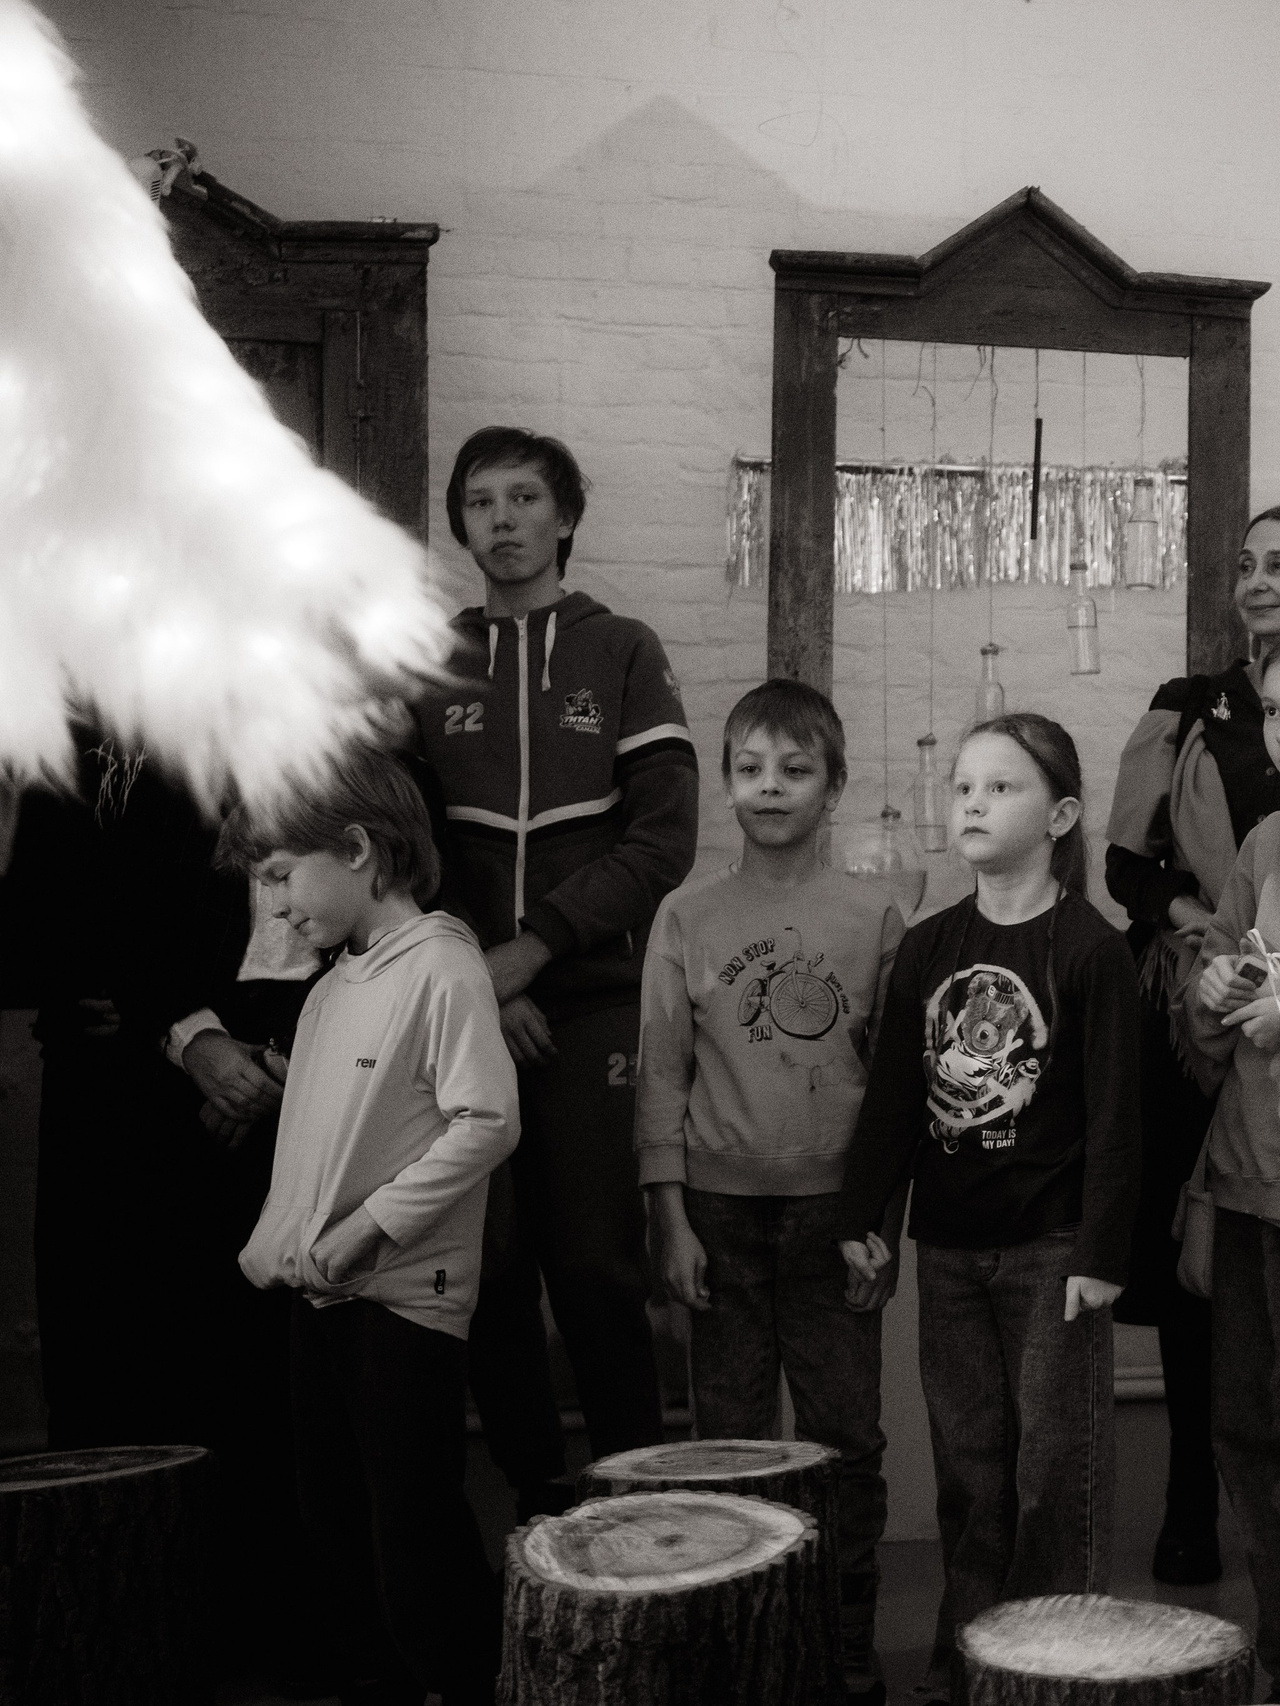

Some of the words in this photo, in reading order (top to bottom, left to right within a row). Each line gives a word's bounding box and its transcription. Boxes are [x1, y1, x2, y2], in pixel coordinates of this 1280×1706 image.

[444, 702, 485, 735] 22
[718, 956, 746, 985] NON
[742, 937, 775, 962] STOP
[748, 1025, 773, 1043] FUN
[981, 1129, 1007, 1140] TODAY
[1008, 1128, 1017, 1139] IS
[981, 1140, 995, 1150] MY
[996, 1138, 1015, 1148] DAY!
